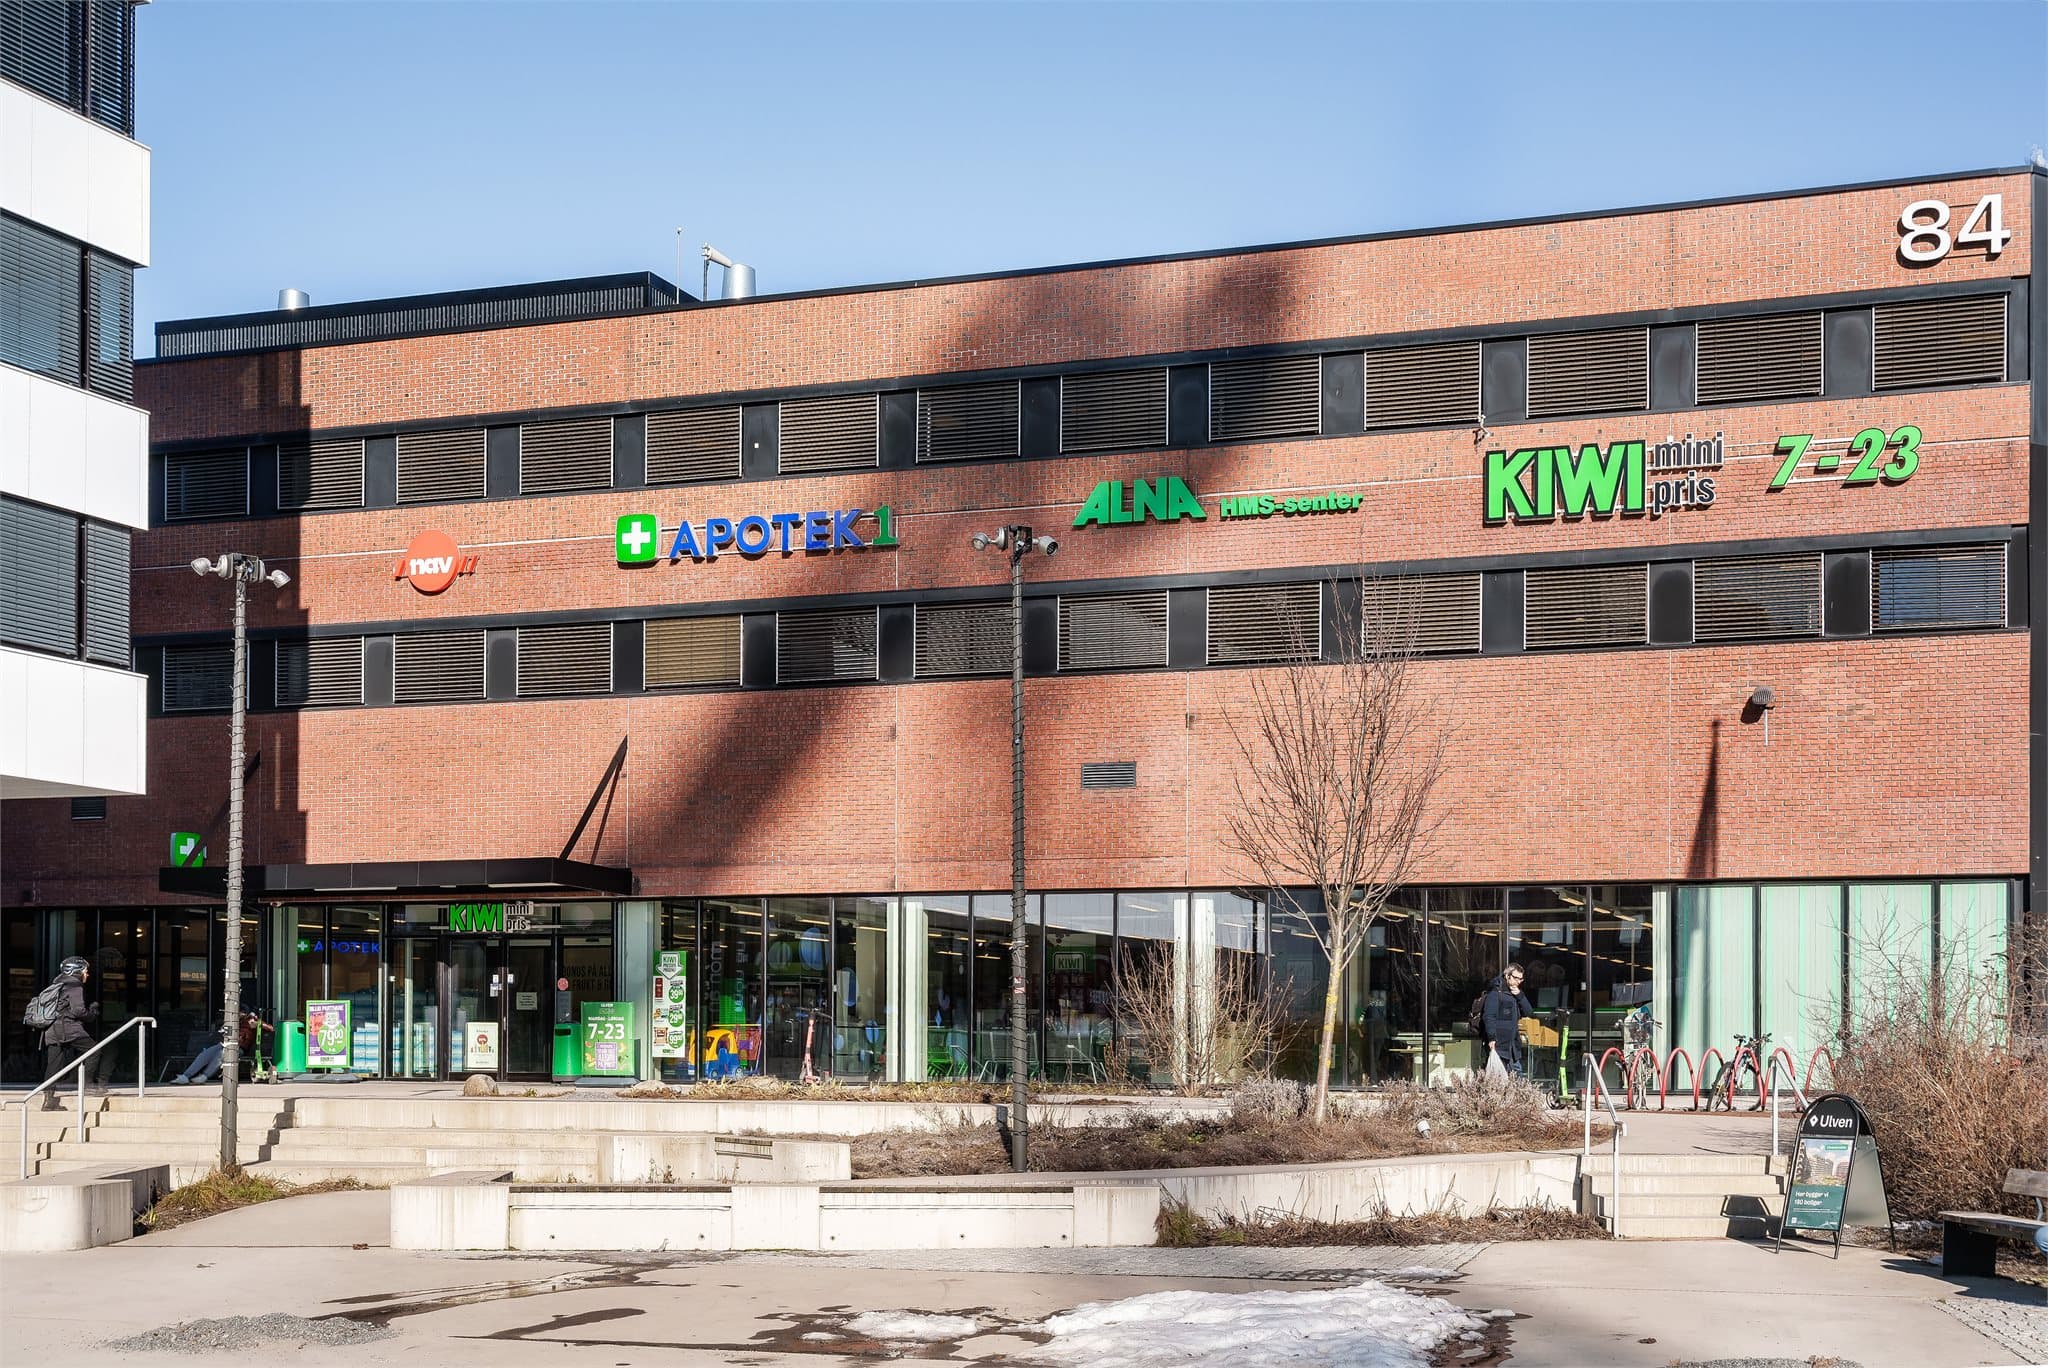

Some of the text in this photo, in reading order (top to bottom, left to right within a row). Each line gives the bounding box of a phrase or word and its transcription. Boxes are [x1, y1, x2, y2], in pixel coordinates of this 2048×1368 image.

[1899, 193, 2012, 262] 84
[1484, 432, 1725, 523] KIWI mini
[1072, 476, 1363, 526] ALNA HMS-senter
[1653, 471, 1717, 514] pris
[669, 504, 898, 559] APOTEK 1
[409, 556, 454, 576] nav
[449, 902, 529, 931] KIWI mini
[506, 917, 528, 931] pris
[1058, 957, 1080, 969] KIWI
[588, 1023, 625, 1040] 7-23
[1819, 1115, 1853, 1129] Ulven
